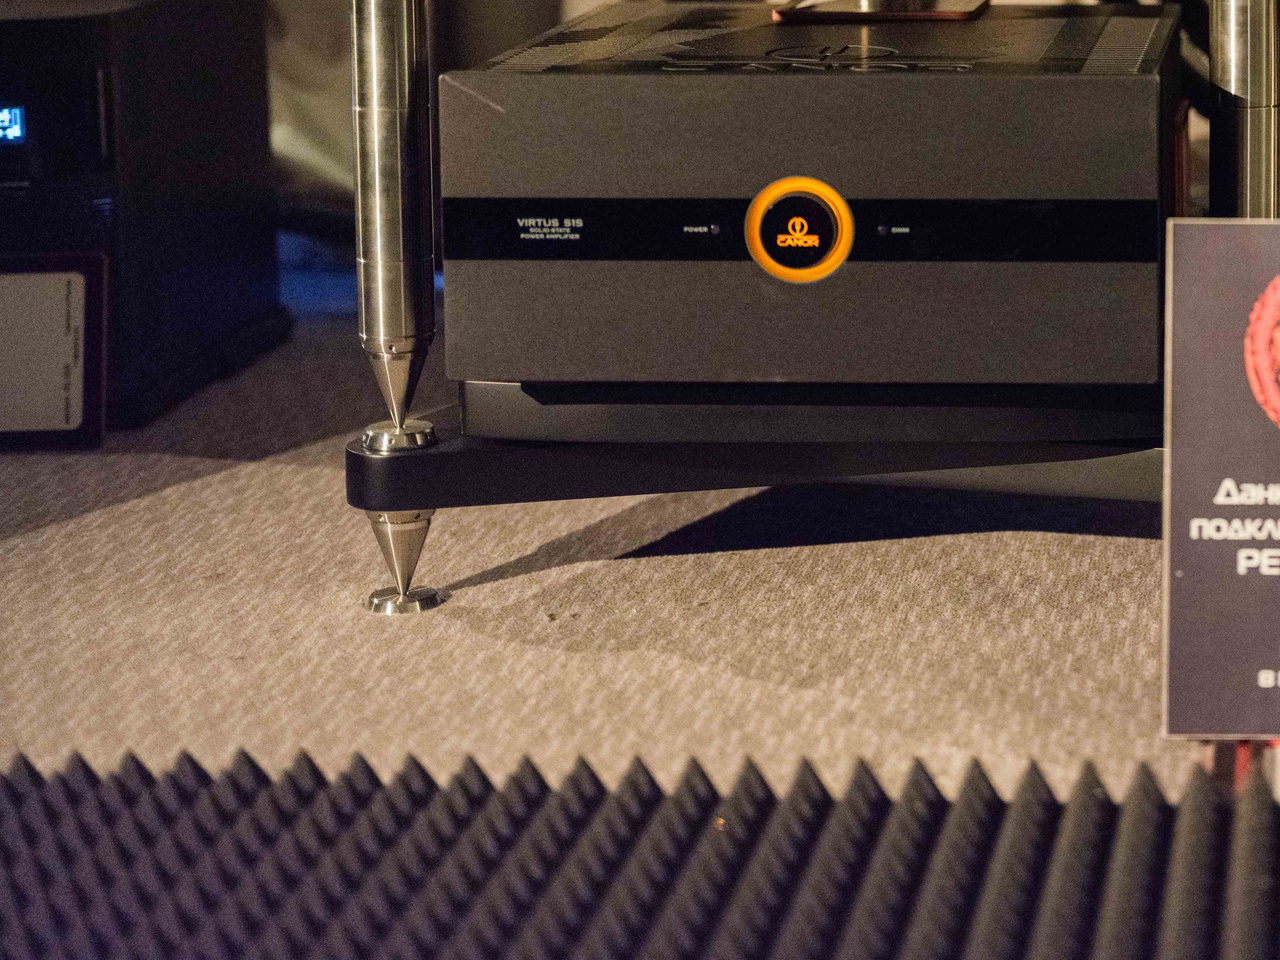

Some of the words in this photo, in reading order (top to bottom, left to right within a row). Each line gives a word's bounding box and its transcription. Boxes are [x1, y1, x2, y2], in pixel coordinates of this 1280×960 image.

[516, 218, 560, 227] VIRTUS
[776, 237, 820, 248] CANOR
[1256, 669, 1277, 689] в
